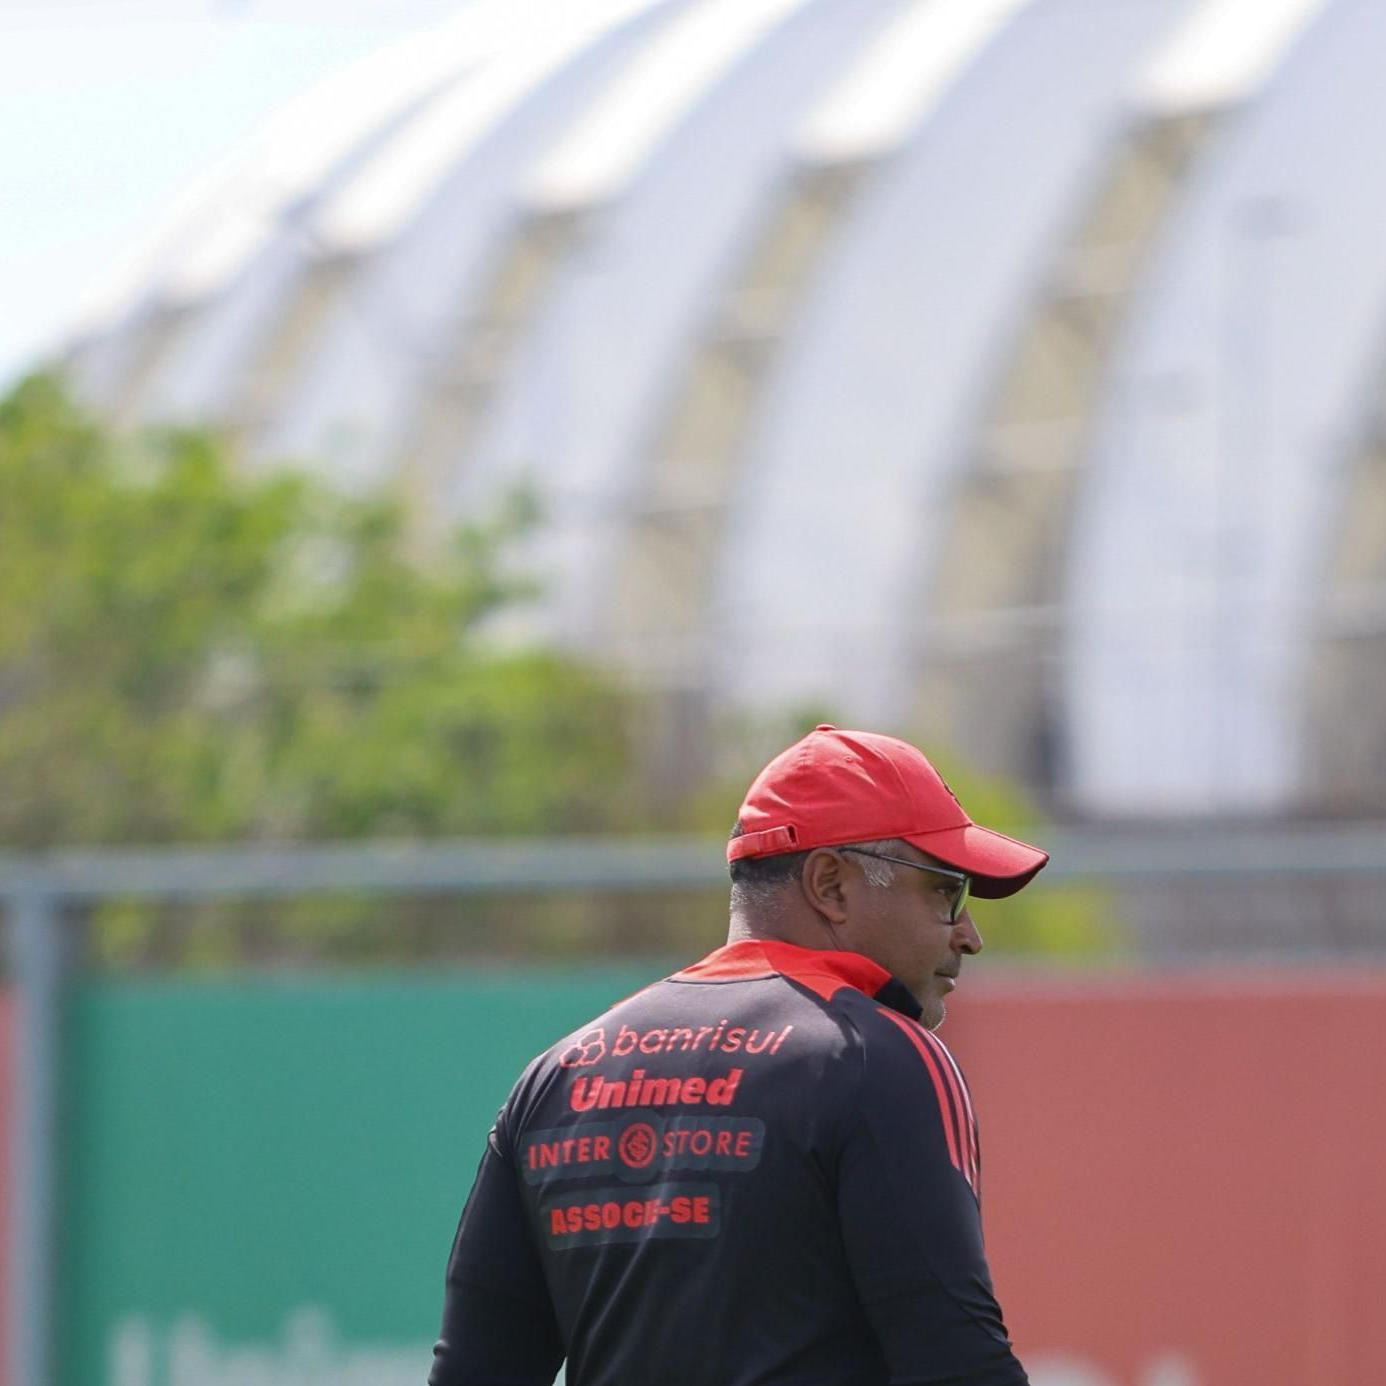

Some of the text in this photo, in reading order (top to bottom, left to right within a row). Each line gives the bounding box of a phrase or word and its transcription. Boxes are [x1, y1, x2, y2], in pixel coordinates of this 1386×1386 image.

[612, 1019, 794, 1057] banrisul
[571, 1069, 743, 1112] Unimed
[527, 1135, 611, 1170] INTER
[662, 1129, 753, 1158] STORE
